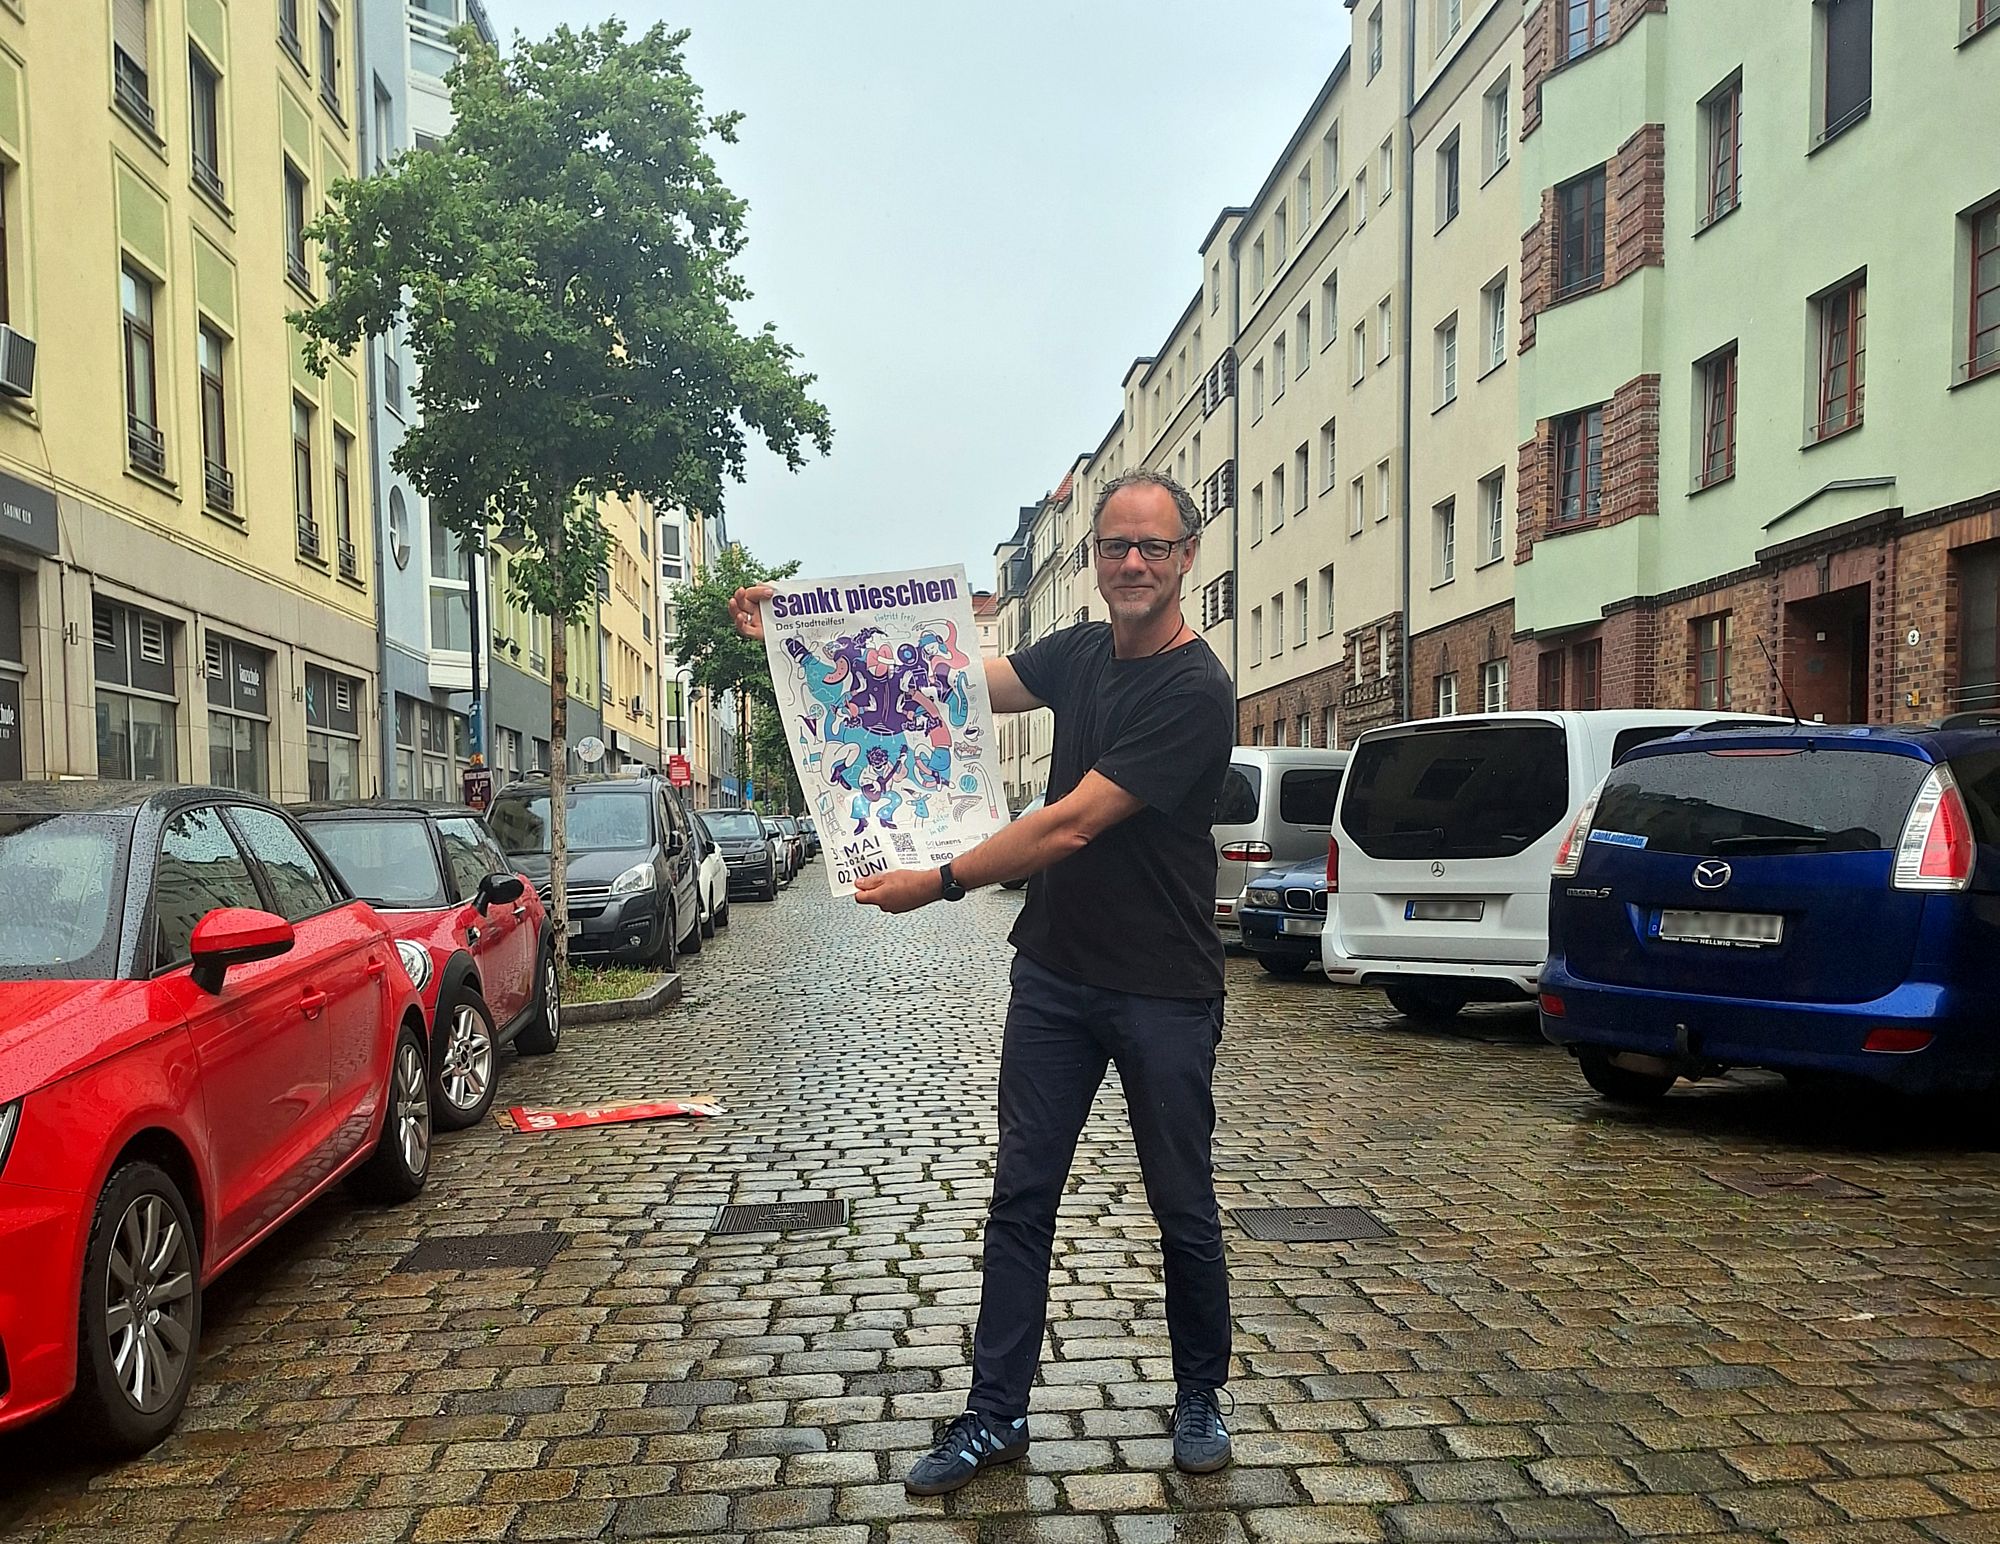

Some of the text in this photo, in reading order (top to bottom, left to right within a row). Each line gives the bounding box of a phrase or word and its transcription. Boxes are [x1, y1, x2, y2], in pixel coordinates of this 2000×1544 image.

[773, 578, 957, 618] sankt pieschen
[775, 617, 845, 631] Das Stadtteilfest
[843, 835, 880, 858] MAI
[844, 854, 866, 867] 2024
[930, 852, 954, 861] ERGO
[838, 870, 852, 884] 02
[853, 857, 888, 879] JUNI
[1699, 938, 1731, 947] HELLWIG
